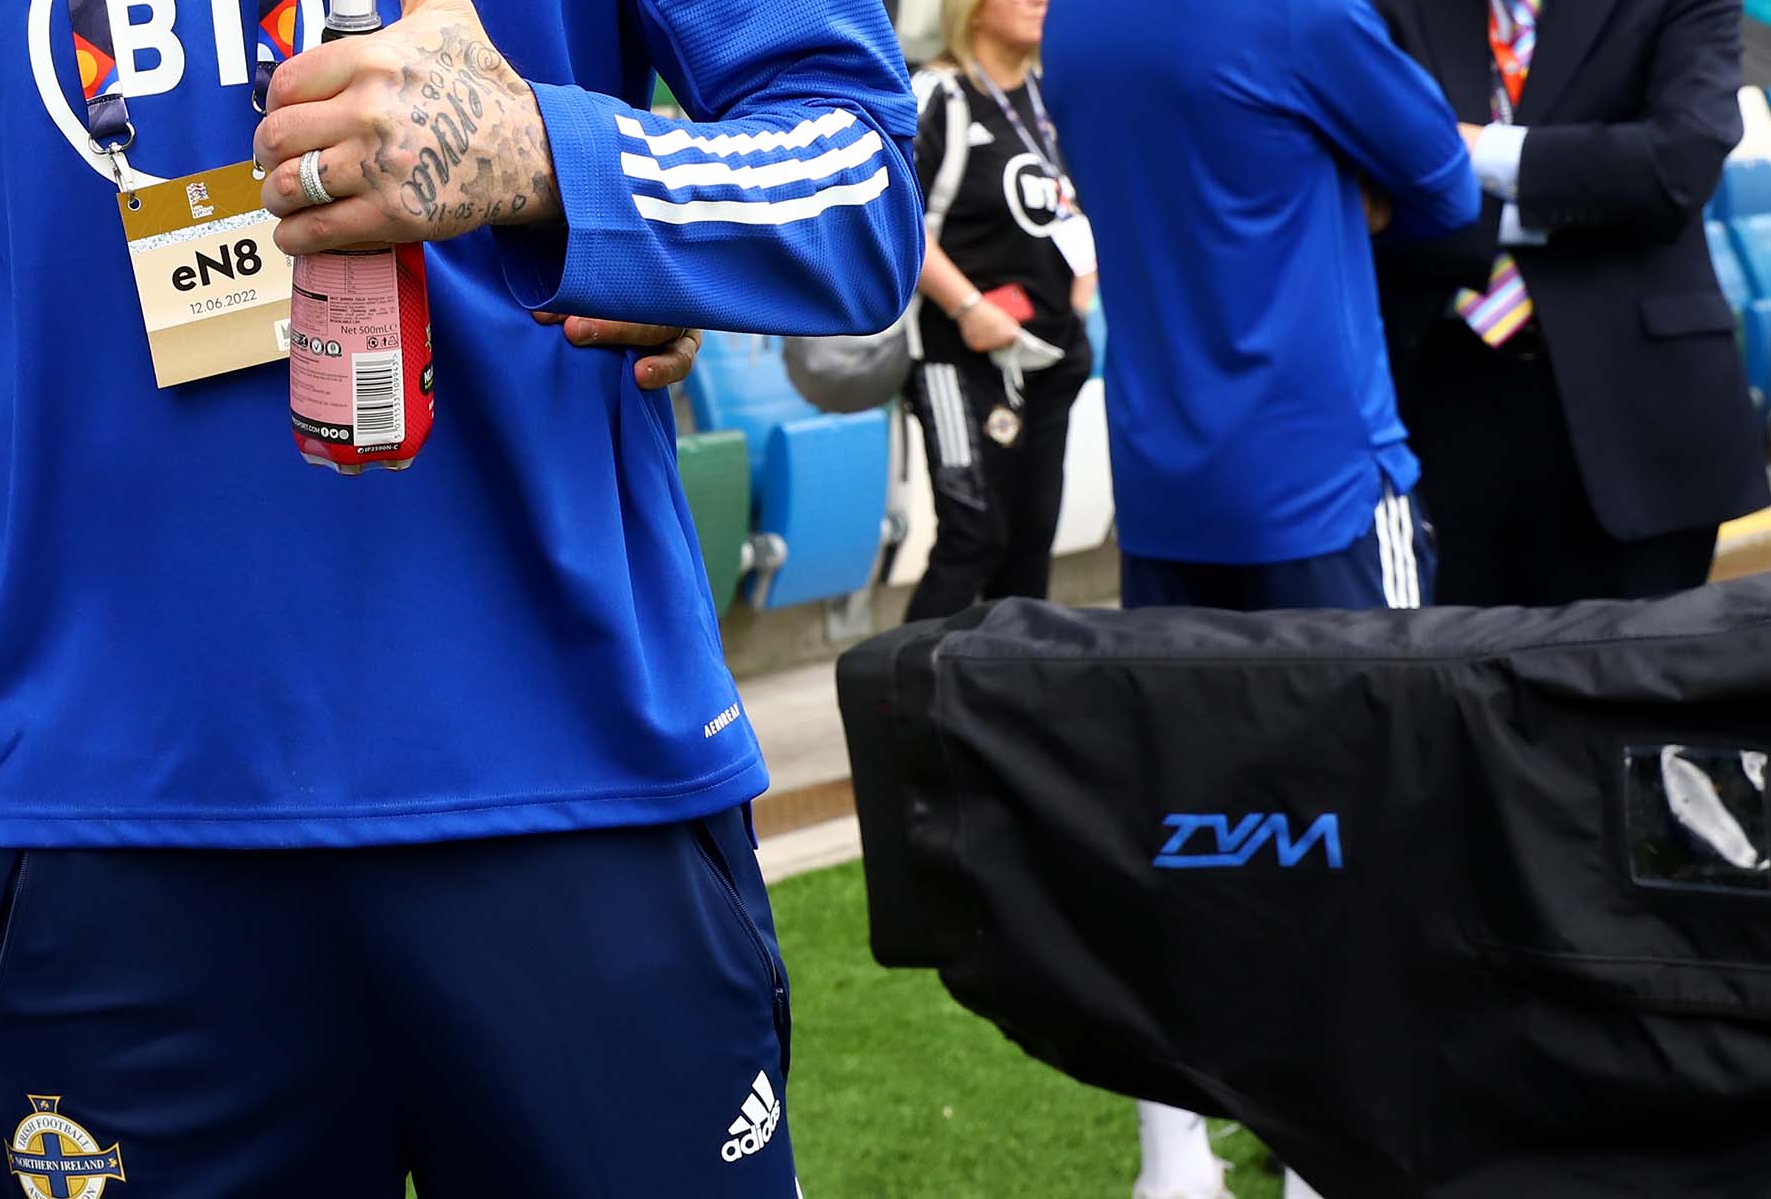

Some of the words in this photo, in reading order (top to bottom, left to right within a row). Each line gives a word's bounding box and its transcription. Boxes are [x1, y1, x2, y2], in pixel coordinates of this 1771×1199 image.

[171, 238, 262, 292] eN8
[189, 289, 258, 315] 12.06.2022
[340, 325, 357, 334] Net
[359, 325, 389, 334] 500mL
[17, 1120, 37, 1147] IRISH
[35, 1116, 90, 1150] FOOTBALL
[721, 1099, 781, 1162] adidas
[14, 1156, 59, 1171] NORTHERN
[60, 1159, 105, 1171] IRELAND
